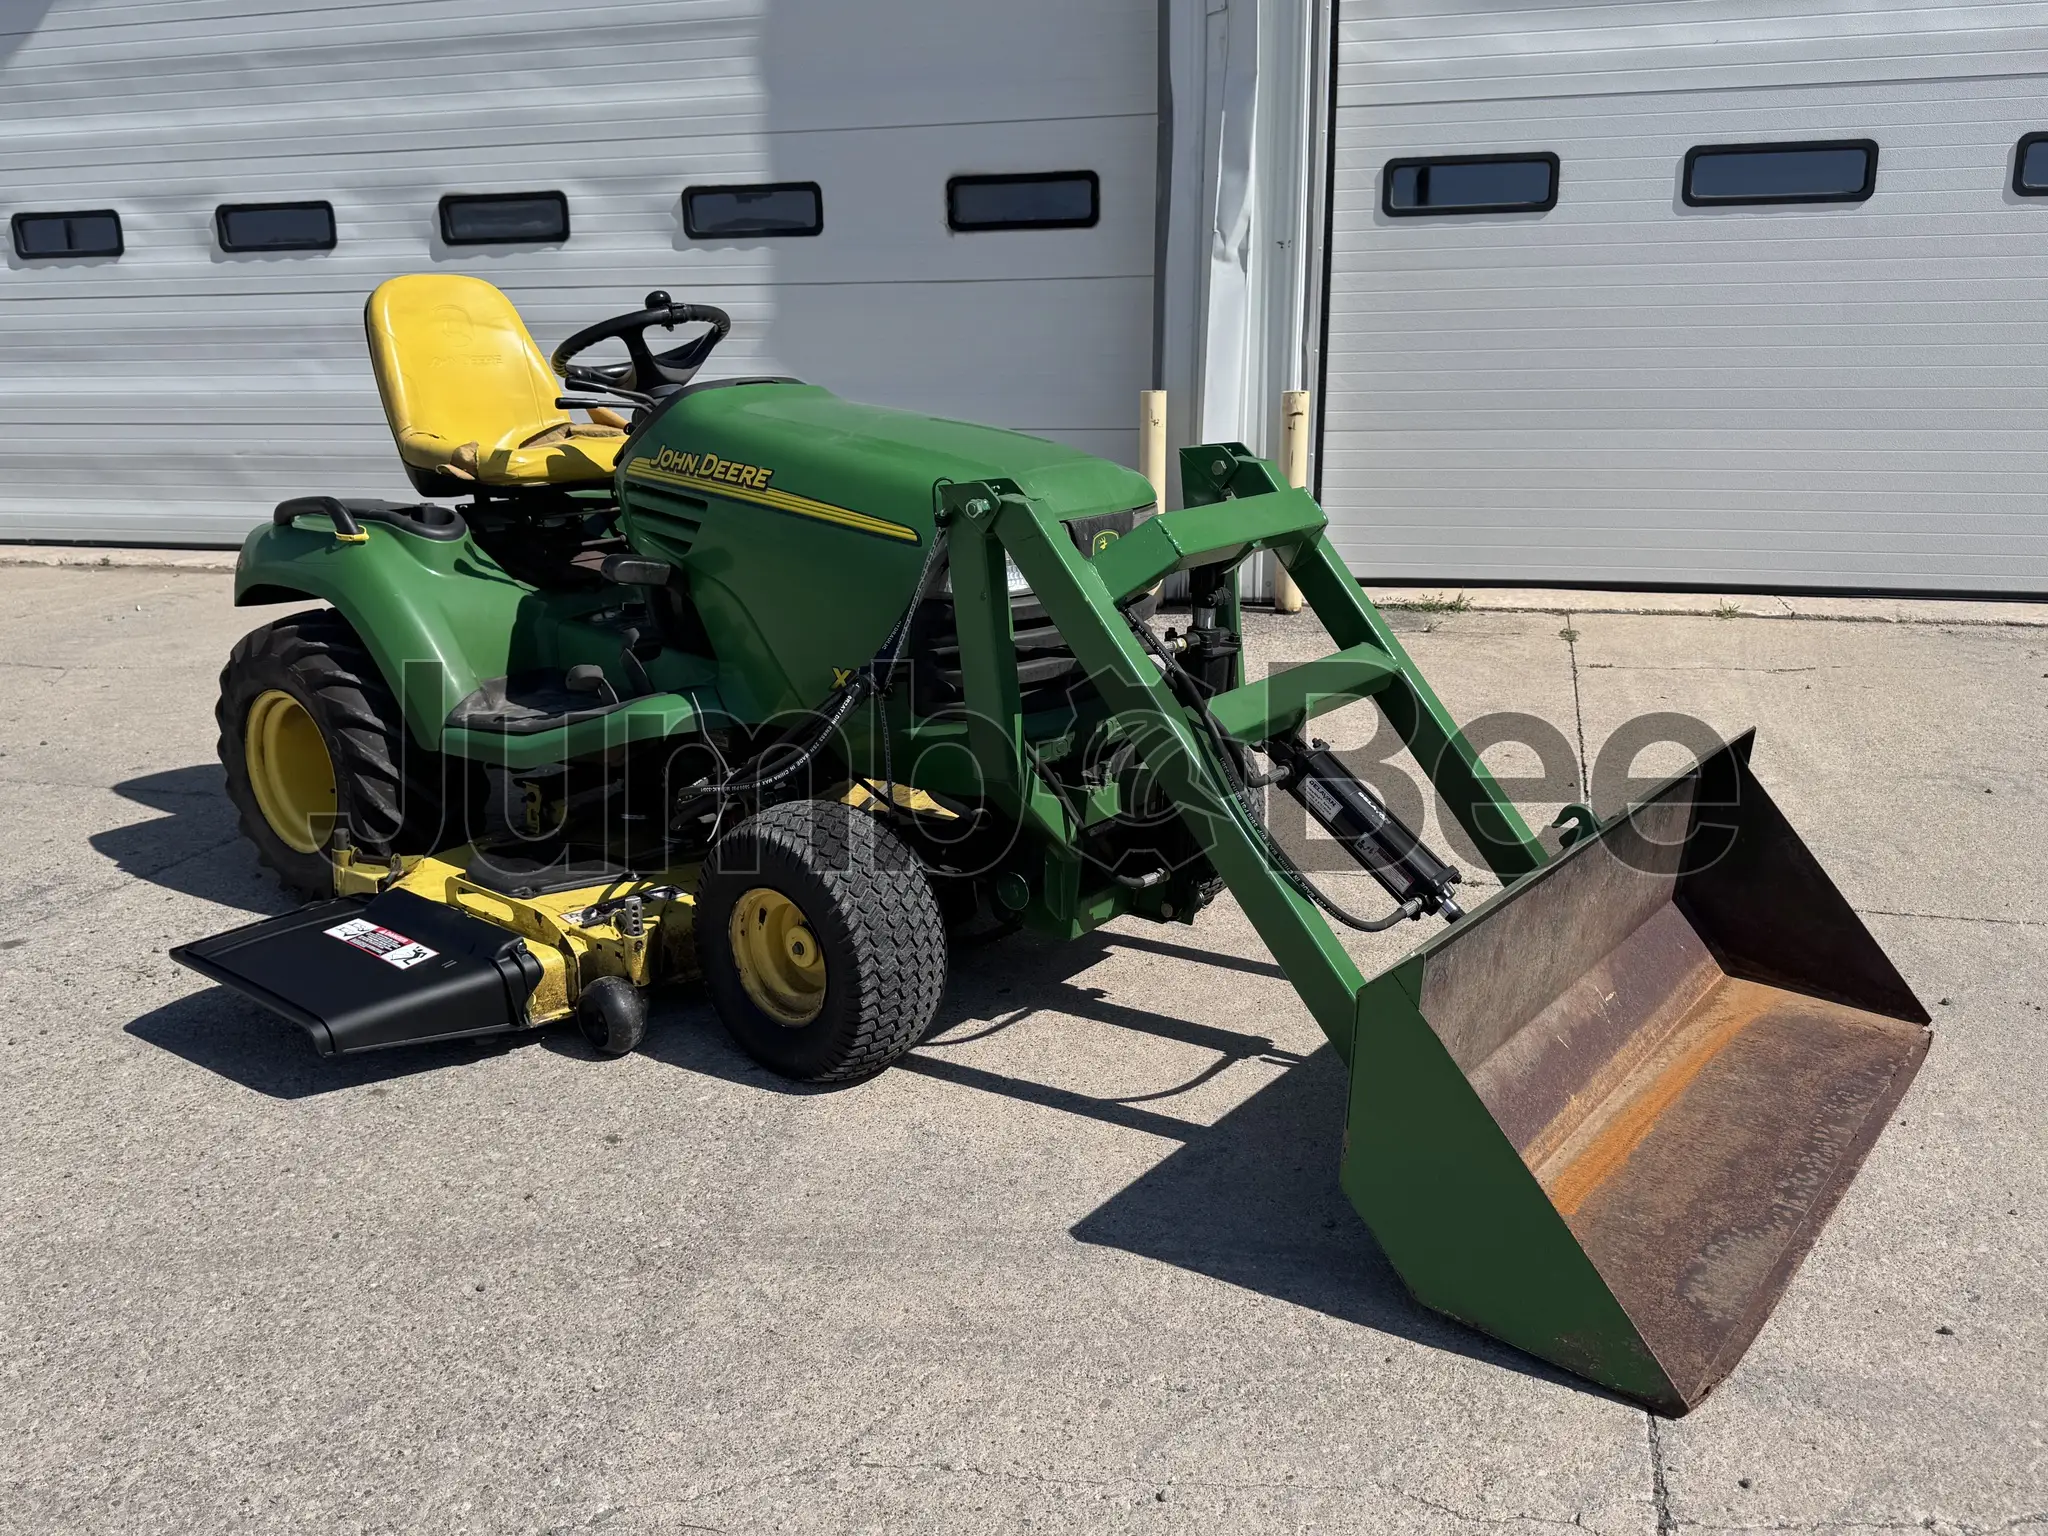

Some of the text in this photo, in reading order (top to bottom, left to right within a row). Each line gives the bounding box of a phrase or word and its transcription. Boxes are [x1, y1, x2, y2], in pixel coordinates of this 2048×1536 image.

[649, 444, 774, 490] JOHN DEERE
[830, 667, 852, 690] X
[795, 752, 810, 766] MADE
[773, 769, 790, 781] CHINA
[789, 764, 797, 772] IN
[1309, 779, 1337, 807] DELAVAN
[1266, 841, 1279, 856] MAX
[1277, 855, 1294, 875] CHINA
[1292, 874, 1301, 882] IN
[1300, 881, 1316, 898] MADE
